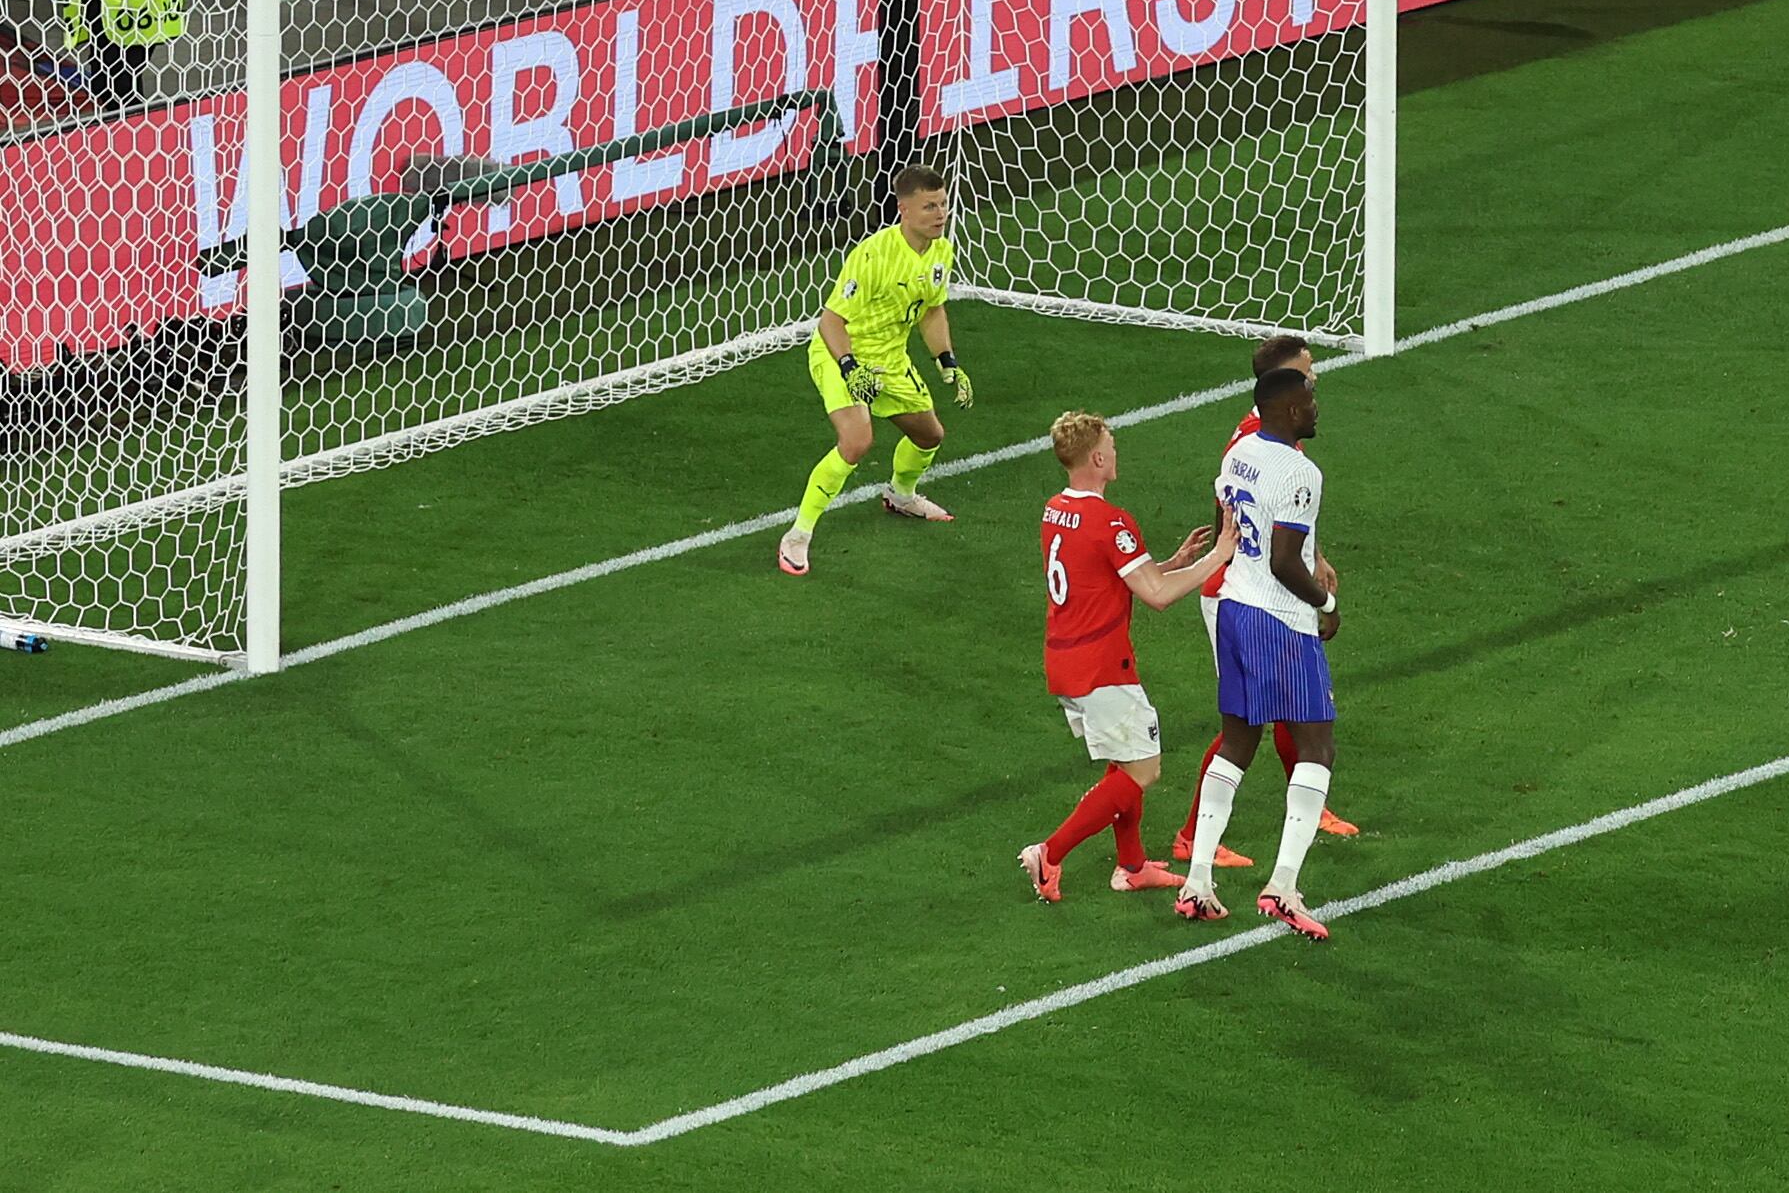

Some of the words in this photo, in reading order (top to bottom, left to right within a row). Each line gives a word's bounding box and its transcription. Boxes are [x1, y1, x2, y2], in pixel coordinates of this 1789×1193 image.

[1229, 457, 1260, 485] THURAM
[1043, 503, 1081, 530] EIWALD
[1046, 532, 1070, 607] 6
